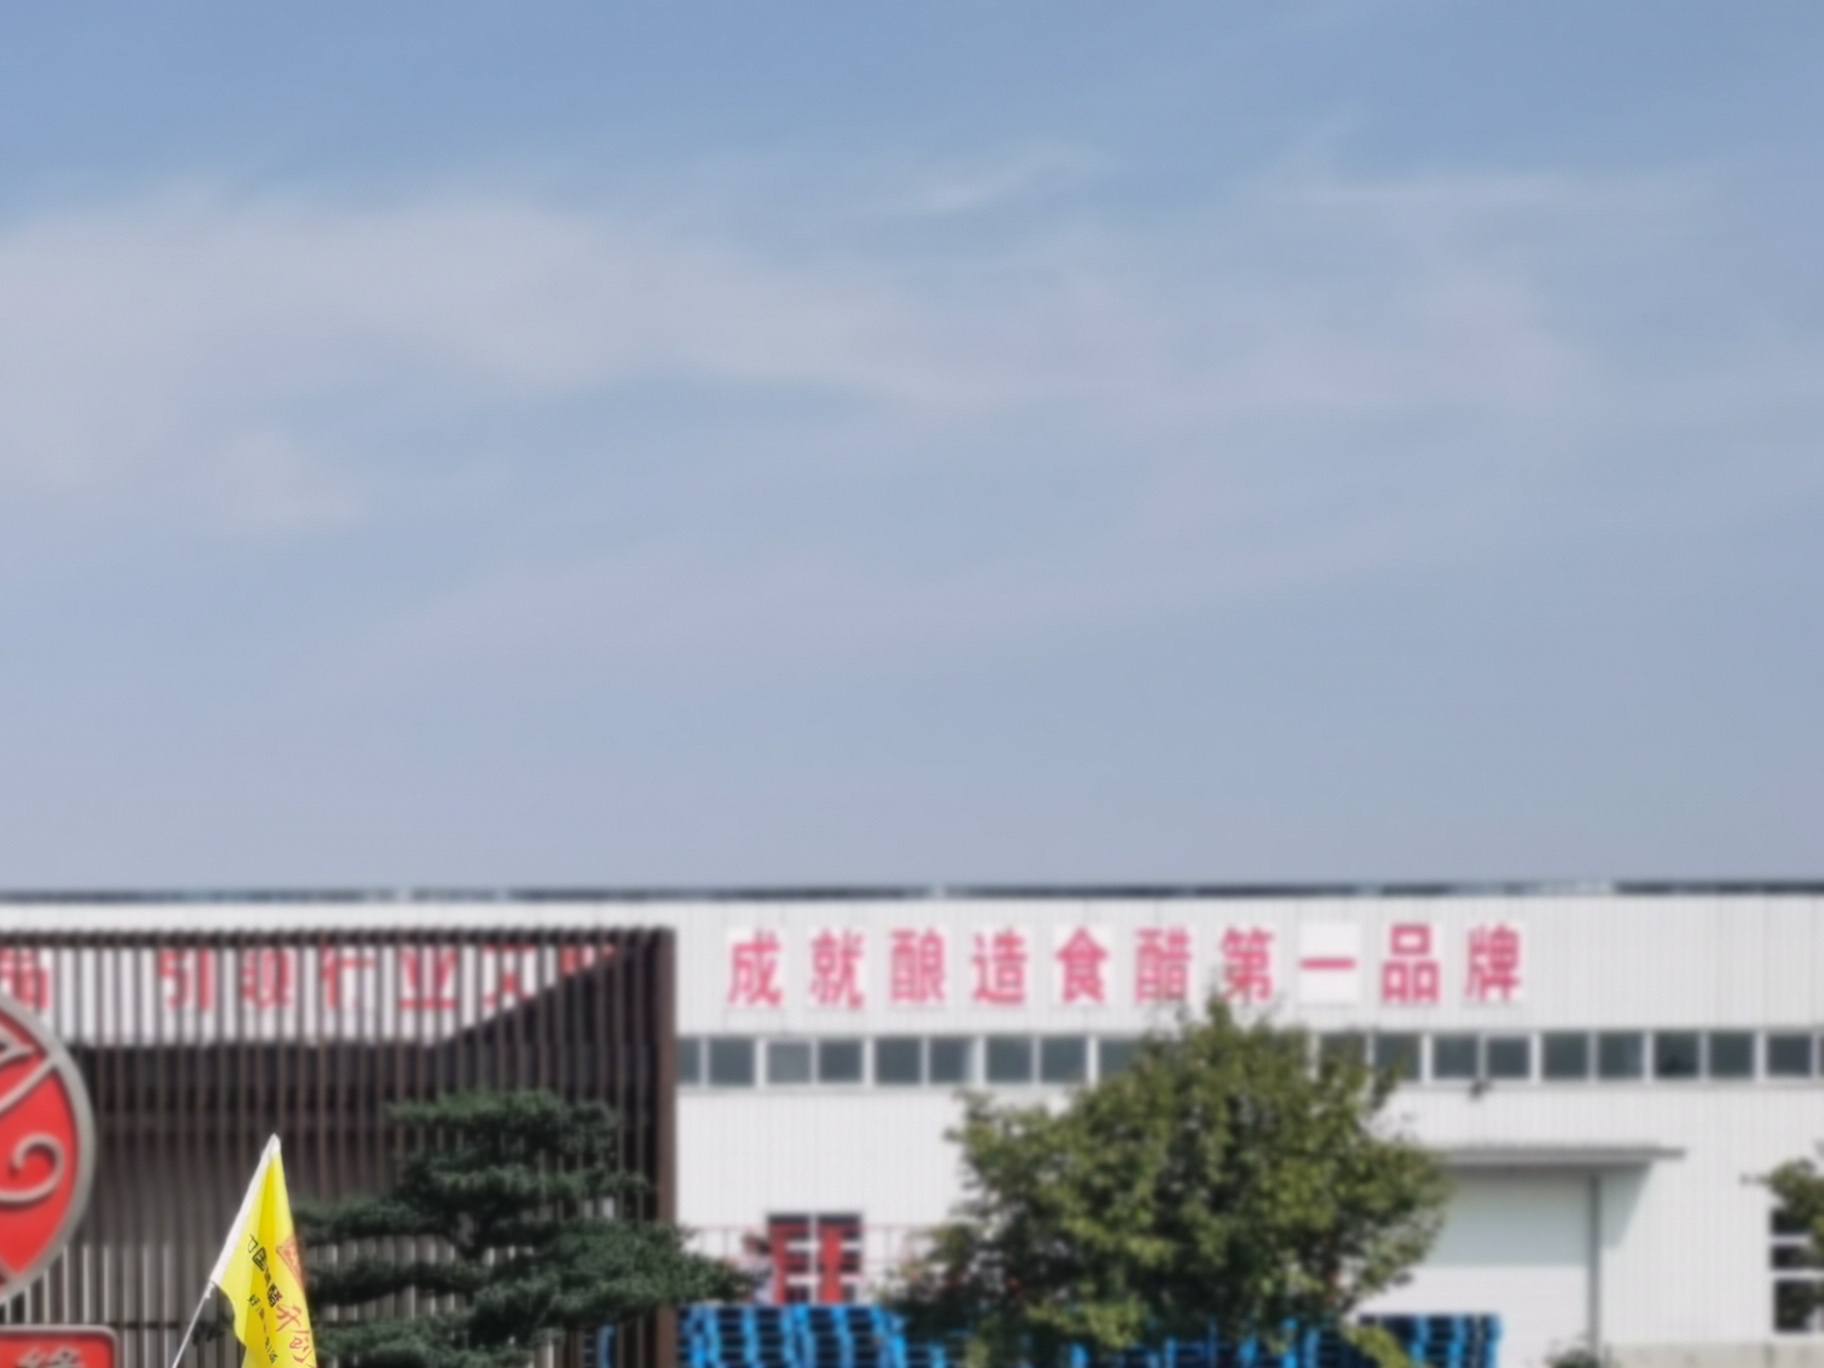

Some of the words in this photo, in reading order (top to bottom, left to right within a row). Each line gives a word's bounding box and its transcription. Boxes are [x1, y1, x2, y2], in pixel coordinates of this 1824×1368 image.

[729, 923, 1520, 1007] 成就酿造食醋第一品牌
